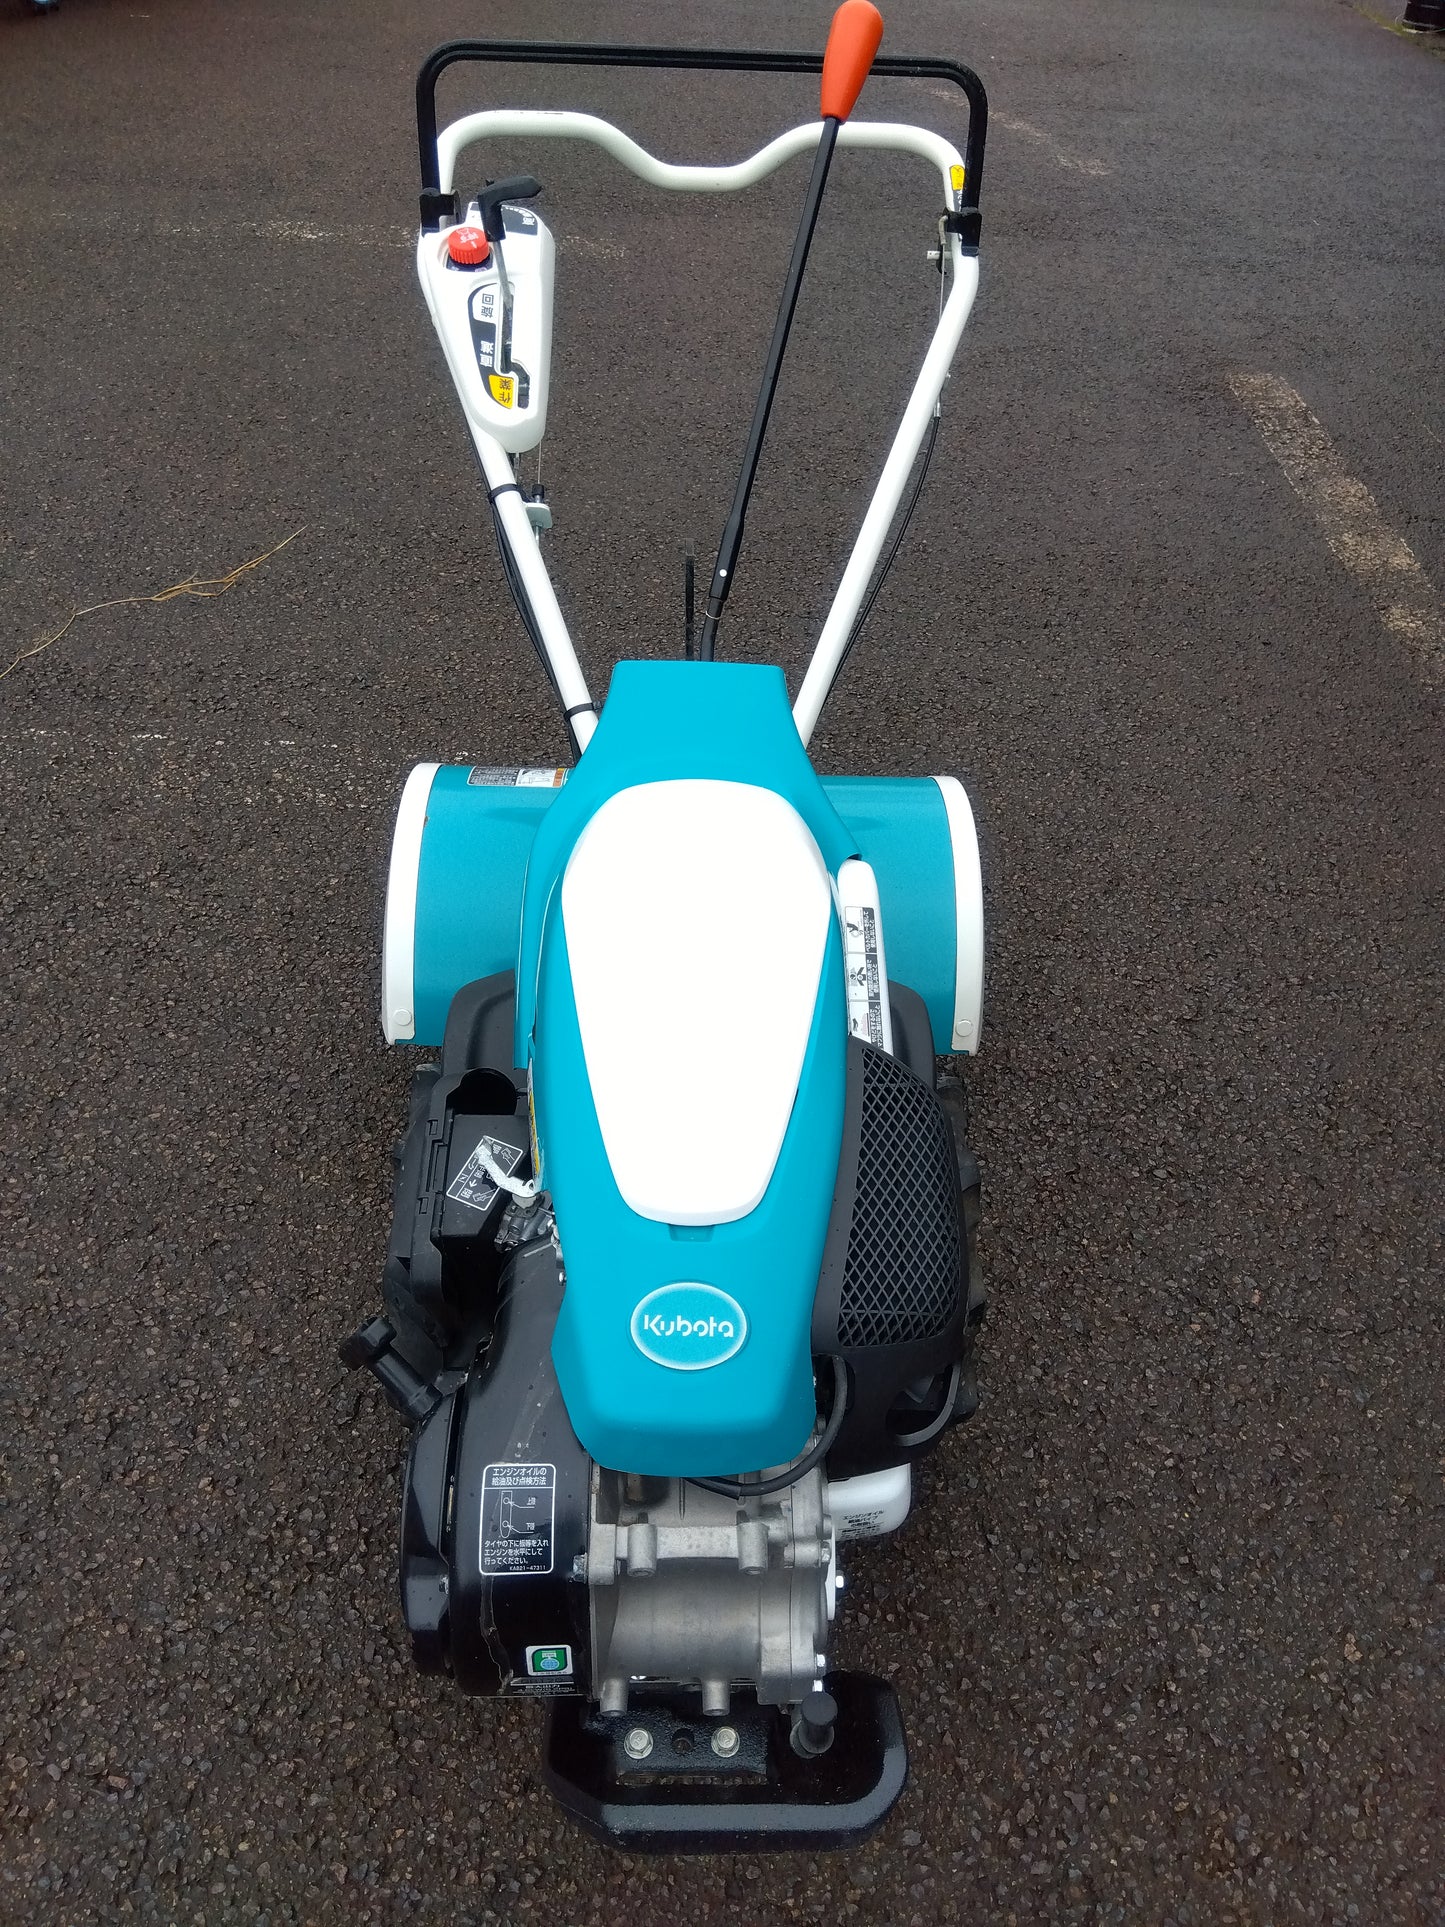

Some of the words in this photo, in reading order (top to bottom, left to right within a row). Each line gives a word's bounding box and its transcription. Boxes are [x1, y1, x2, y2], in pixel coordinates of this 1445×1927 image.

[481, 293, 495, 319] 旋回
[480, 340, 494, 368] 直進
[643, 1314, 734, 1338] Kubota
[492, 1467, 547, 1476] エンジンオイルの
[491, 1476, 547, 1486] 給油及び点検方法
[484, 1548, 543, 1556] エンジンを水平にして
